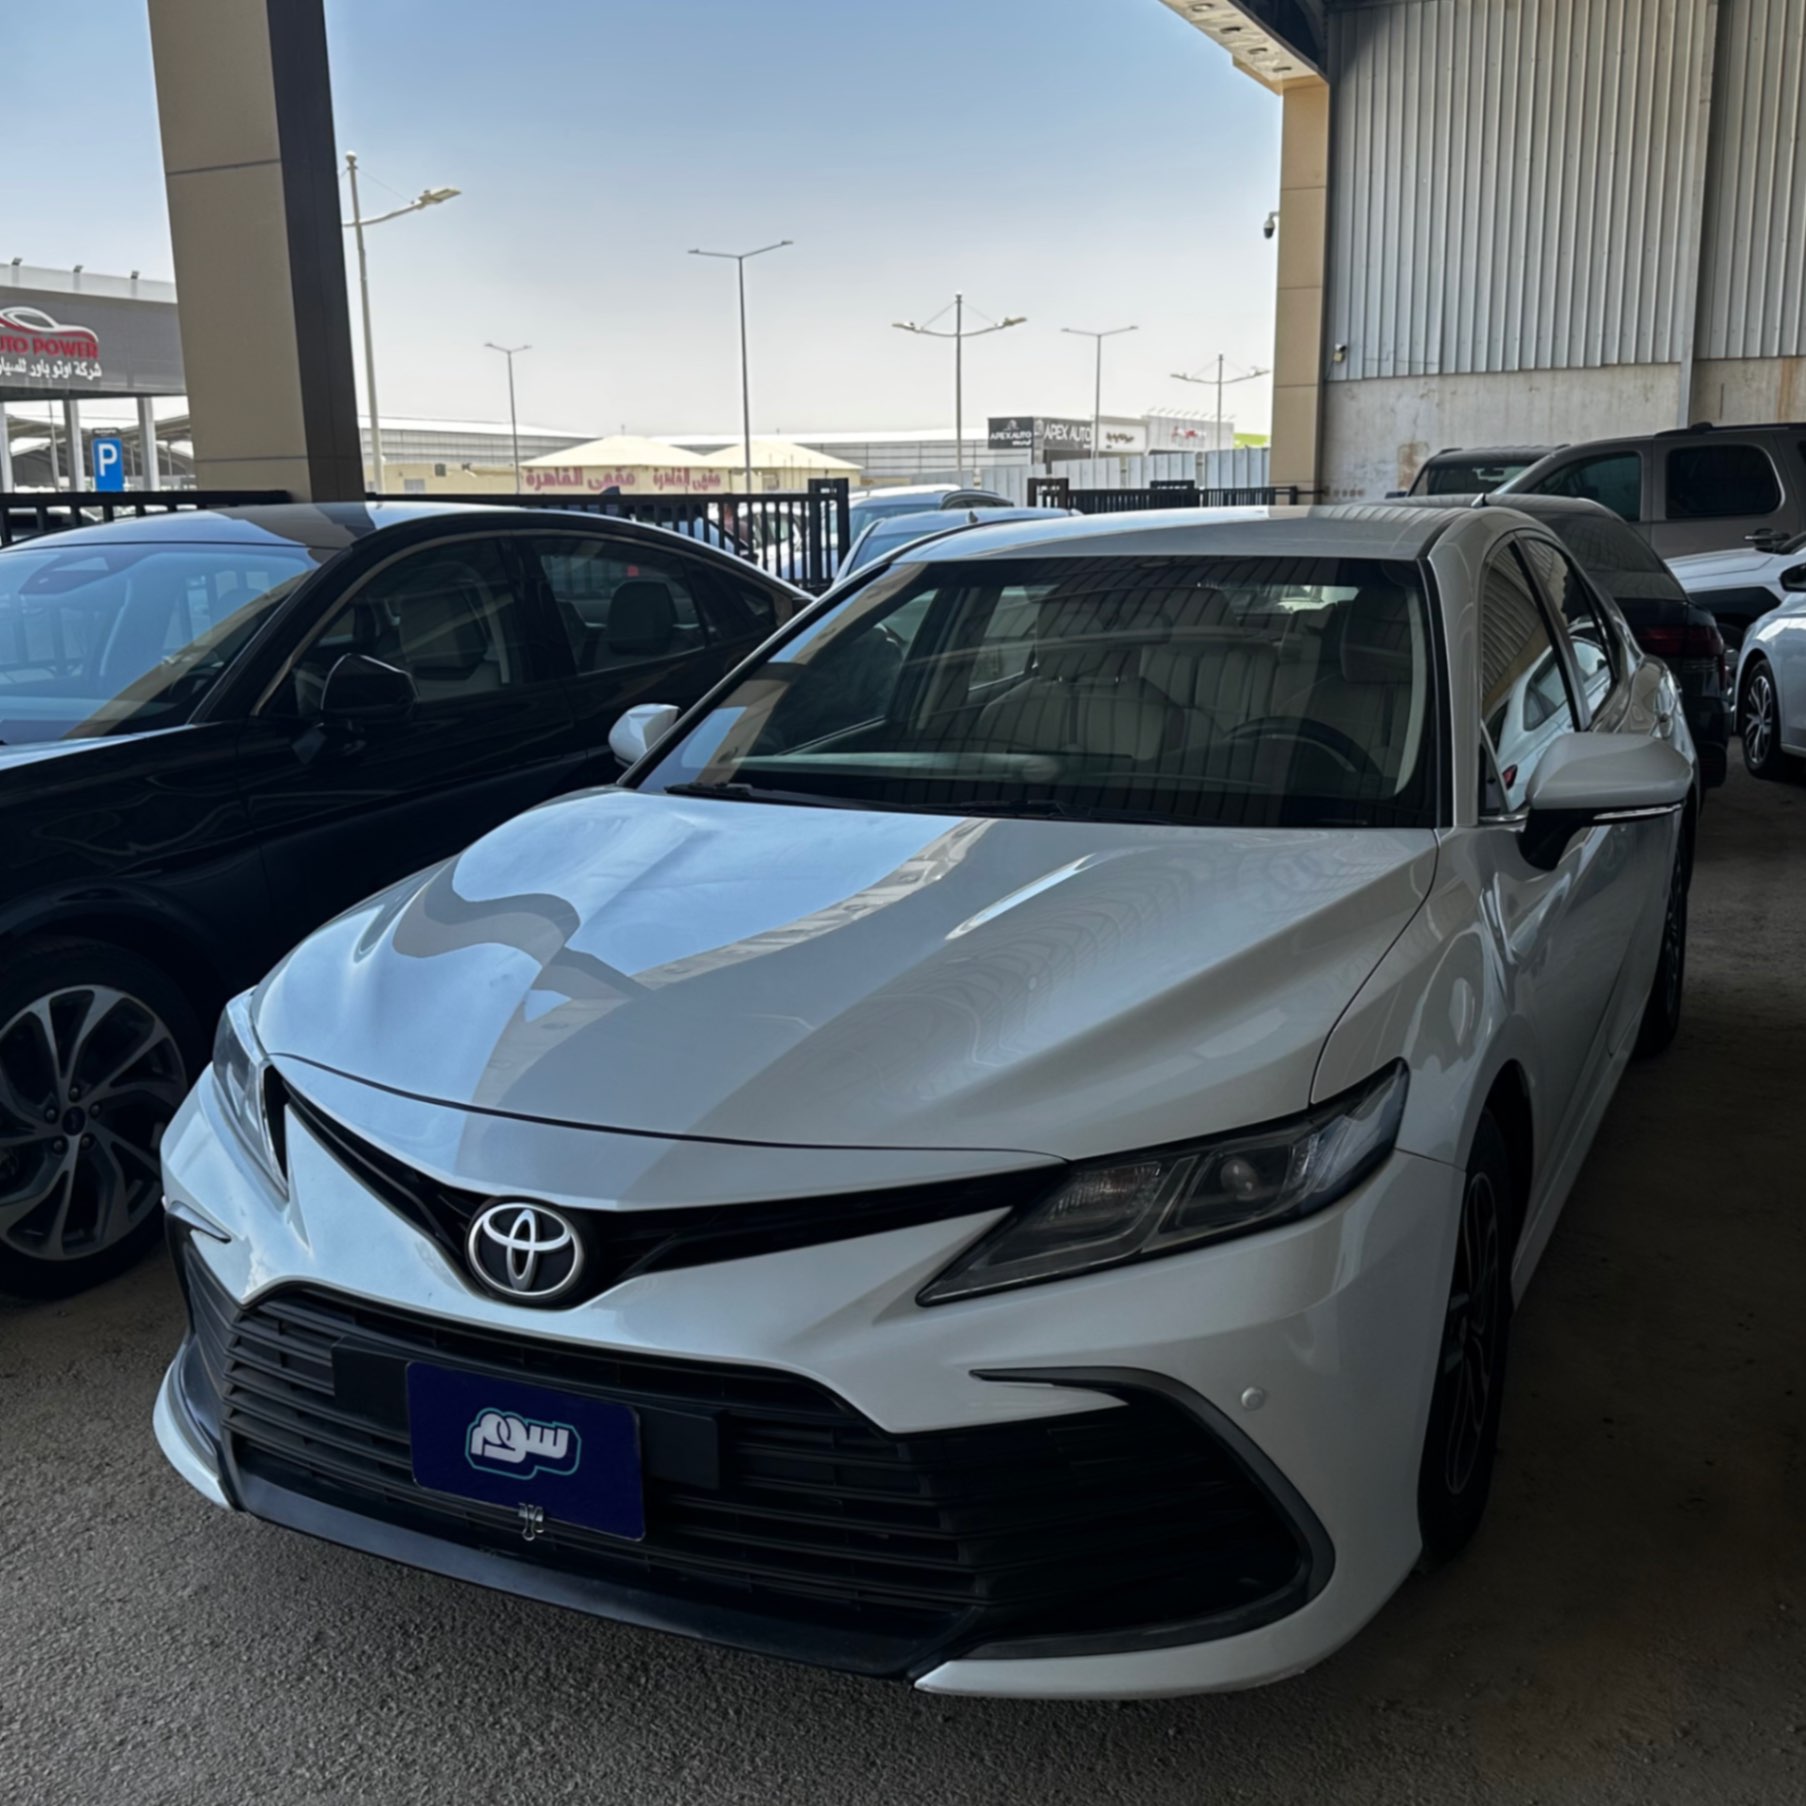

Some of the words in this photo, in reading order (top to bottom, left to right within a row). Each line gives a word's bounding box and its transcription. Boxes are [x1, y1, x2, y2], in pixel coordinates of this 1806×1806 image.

[0, 336, 29, 354] UTO
[33, 337, 98, 359] POWER
[29, 359, 50, 377] باور
[73, 361, 102, 380] شركة
[1043, 423, 1068, 441] APEX
[1068, 425, 1091, 443] AUTO
[98, 443, 118, 477] P
[526, 466, 583, 491] القاهرة
[653, 467, 690, 491] القاهرة
